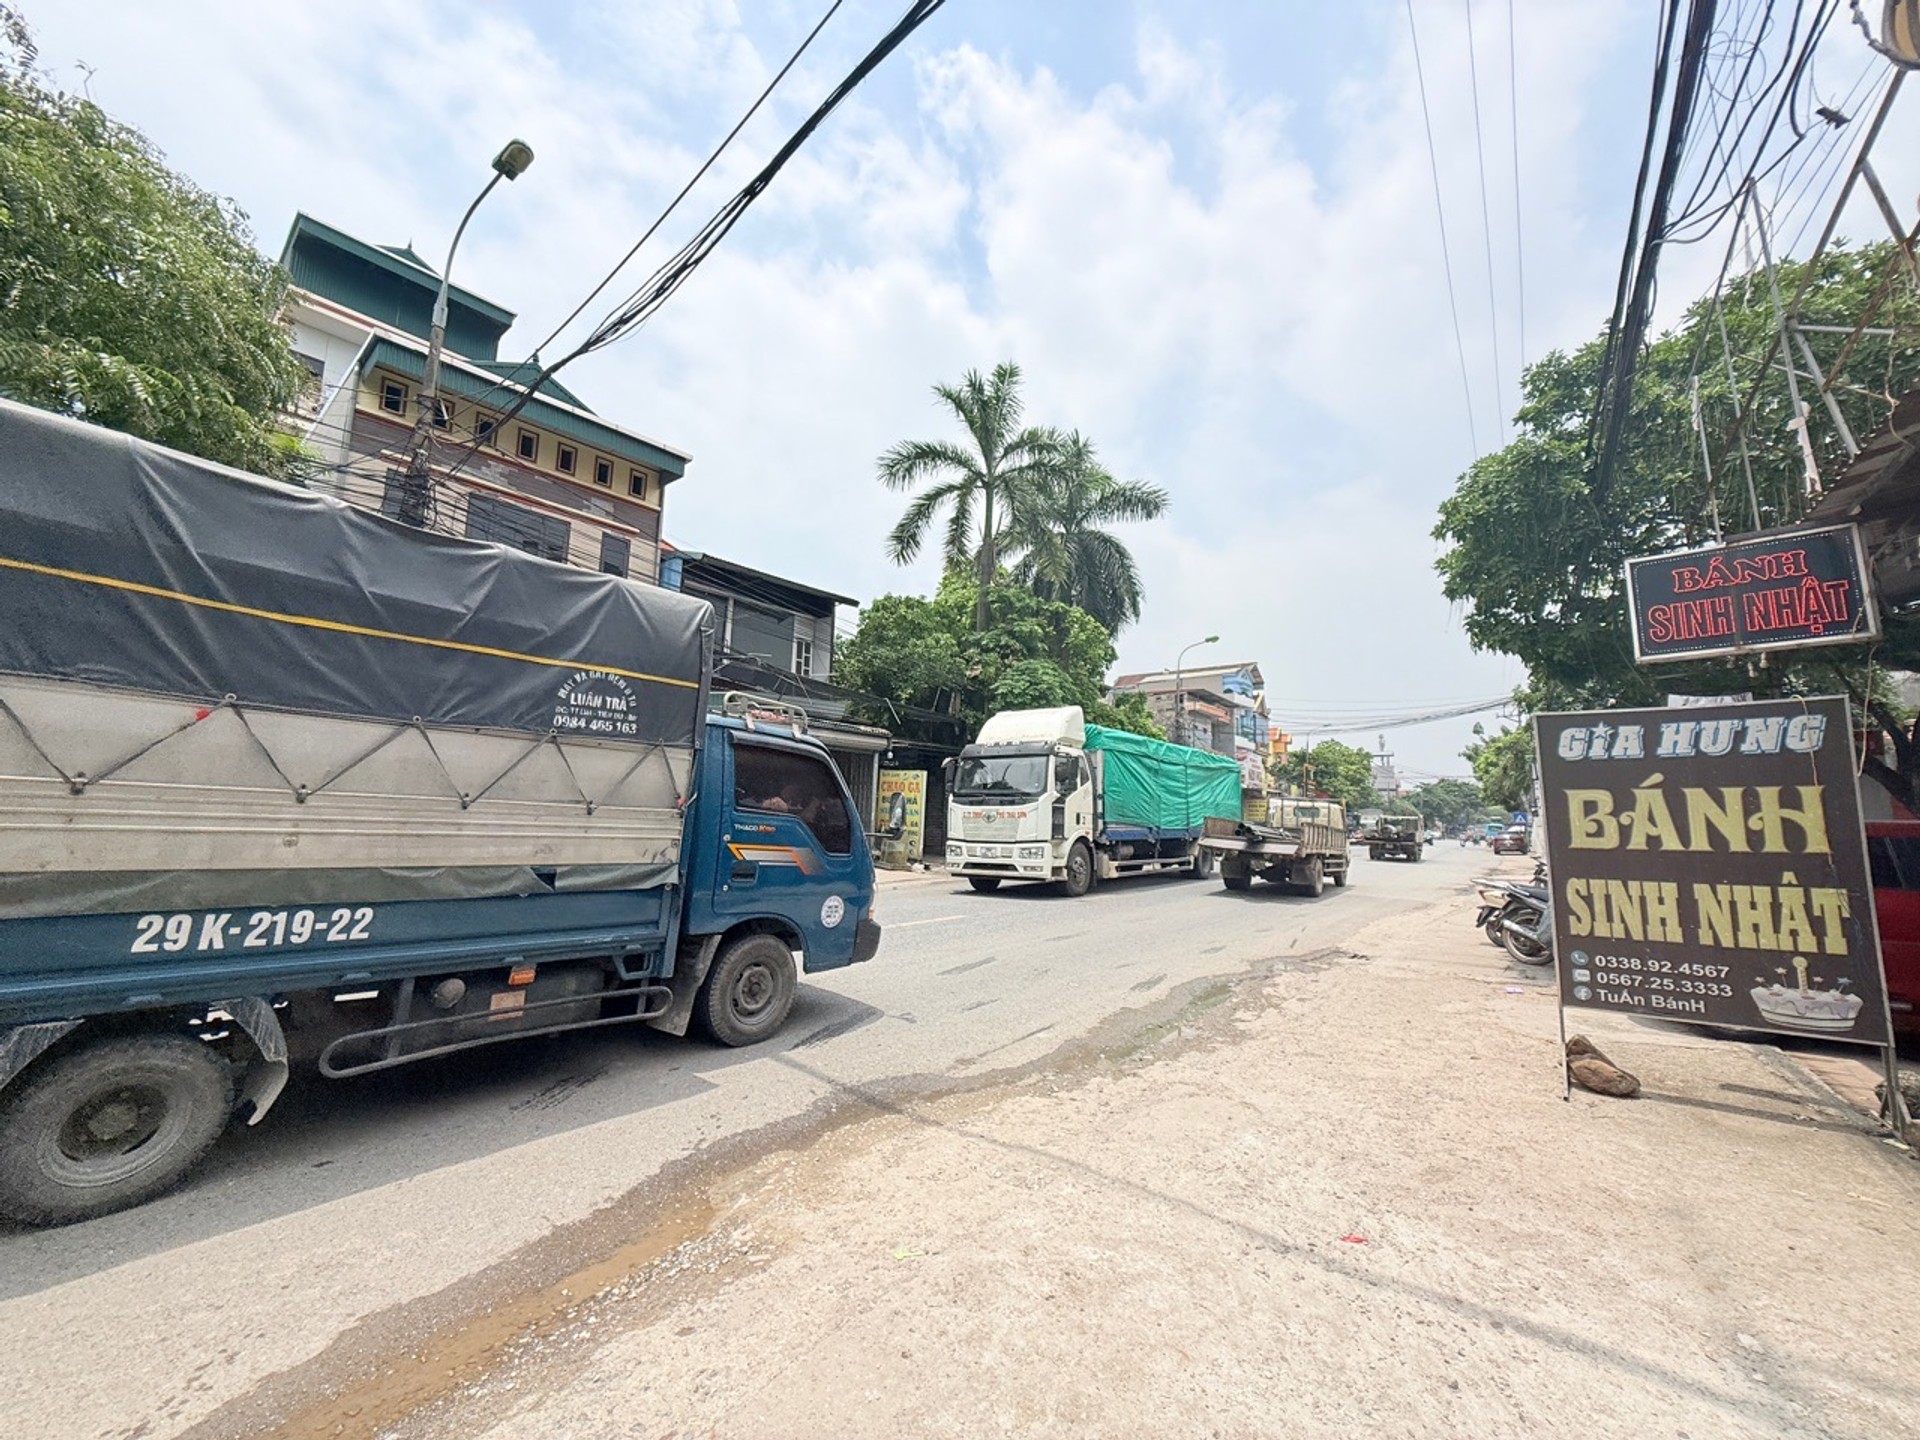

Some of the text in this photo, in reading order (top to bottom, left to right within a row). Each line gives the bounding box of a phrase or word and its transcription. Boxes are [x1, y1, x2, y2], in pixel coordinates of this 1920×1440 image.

[1672, 549, 1809, 593] BÁNH
[1648, 575, 1849, 643] SINH NHẬT
[616, 721, 637, 735] 163
[1563, 773, 1832, 853] BÁNH
[1566, 877, 1684, 944] SINH
[1595, 955, 1730, 979] 0338.92.4567
[1596, 972, 1734, 998] 0567.25.3333
